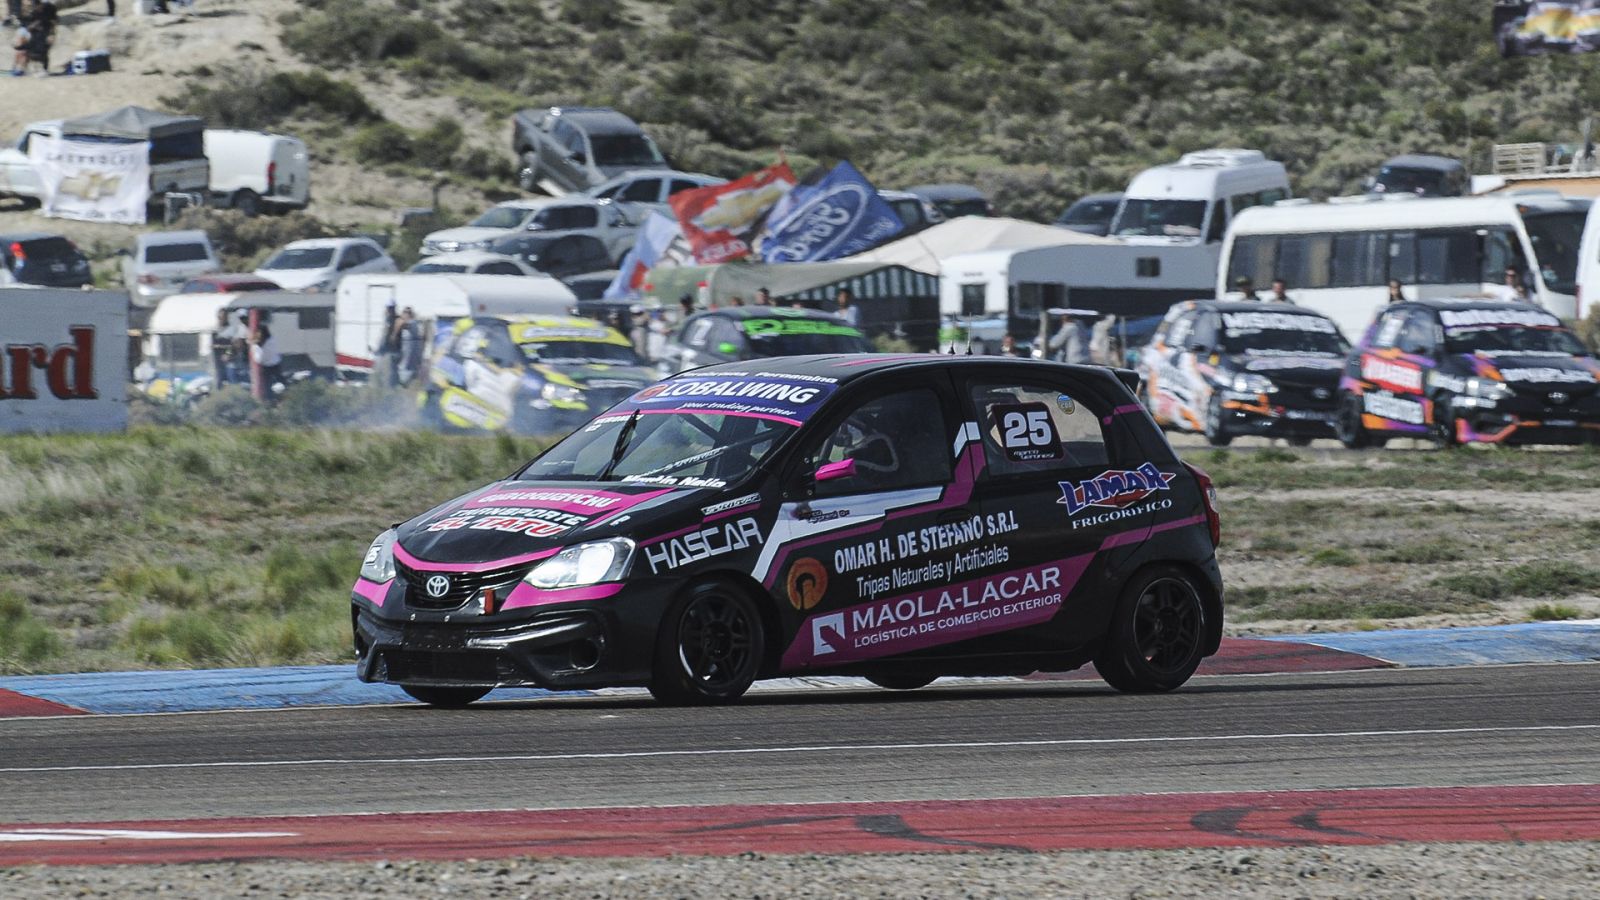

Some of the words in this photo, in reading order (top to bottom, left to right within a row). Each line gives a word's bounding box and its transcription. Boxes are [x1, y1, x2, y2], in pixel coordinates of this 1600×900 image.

[0, 324, 98, 400] rd
[633, 381, 820, 403] GLOBALWING
[675, 401, 709, 411] your
[708, 402, 751, 413] trading
[748, 405, 797, 417] partner
[1003, 411, 1052, 448] 25
[449, 505, 589, 525] TRANSPORTE
[1058, 462, 1170, 516] LAMAR
[427, 514, 470, 532] EL
[469, 515, 572, 538] TATU
[644, 516, 763, 575] HASCAR
[834, 543, 877, 574] OMAR
[879, 538, 896, 563] H.
[897, 533, 918, 559] DE
[921, 514, 984, 551] STEFANO
[987, 510, 1019, 537] S.R.L
[853, 566, 1062, 632] MAOLA-LACAR
[856, 574, 891, 600] Tripas
[892, 558, 945, 589] Naturales
[945, 565, 952, 582] y
[954, 545, 1009, 574] Artificiales
[854, 620, 918, 648] LOGÍSTICA
[919, 618, 936, 633] DE
[937, 607, 1001, 630] COMERCIO
[1003, 593, 1062, 615] EXTERIOR
